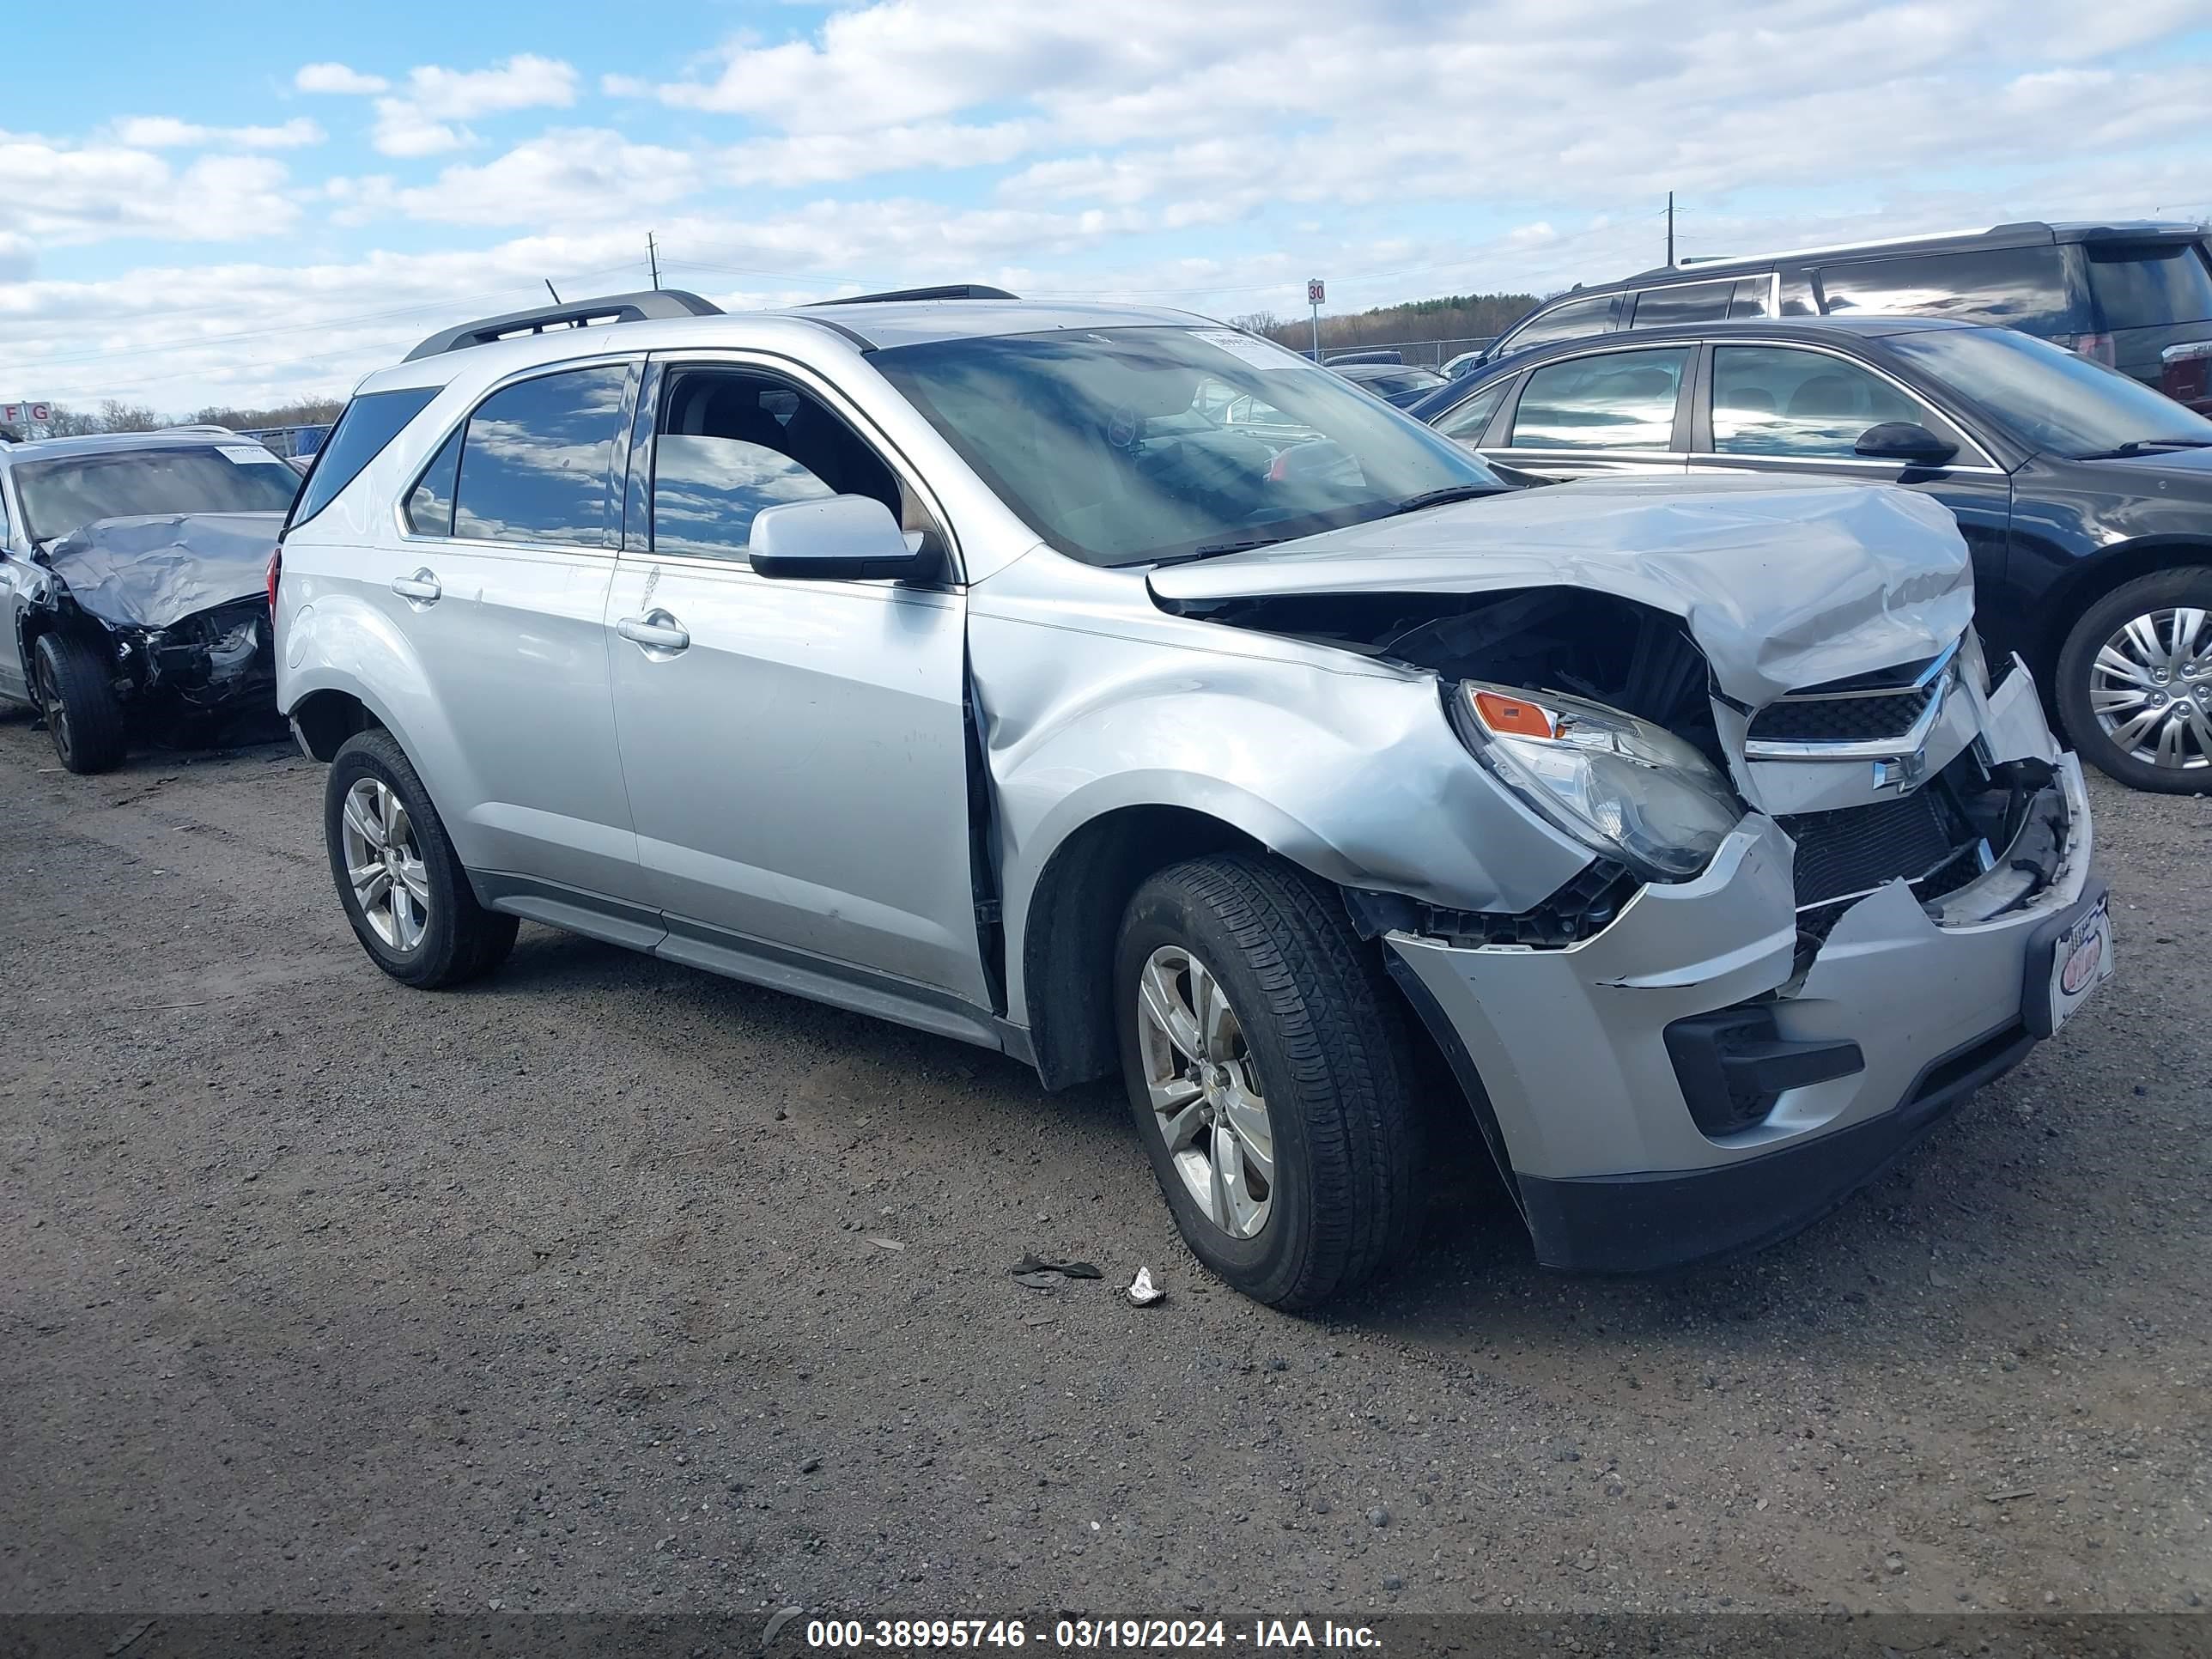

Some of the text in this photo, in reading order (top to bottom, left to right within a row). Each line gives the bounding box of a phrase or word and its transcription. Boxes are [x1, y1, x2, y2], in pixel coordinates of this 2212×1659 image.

[1310, 285, 1324, 300] 30
[6, 406, 16, 421] F
[33, 405, 48, 420] G
